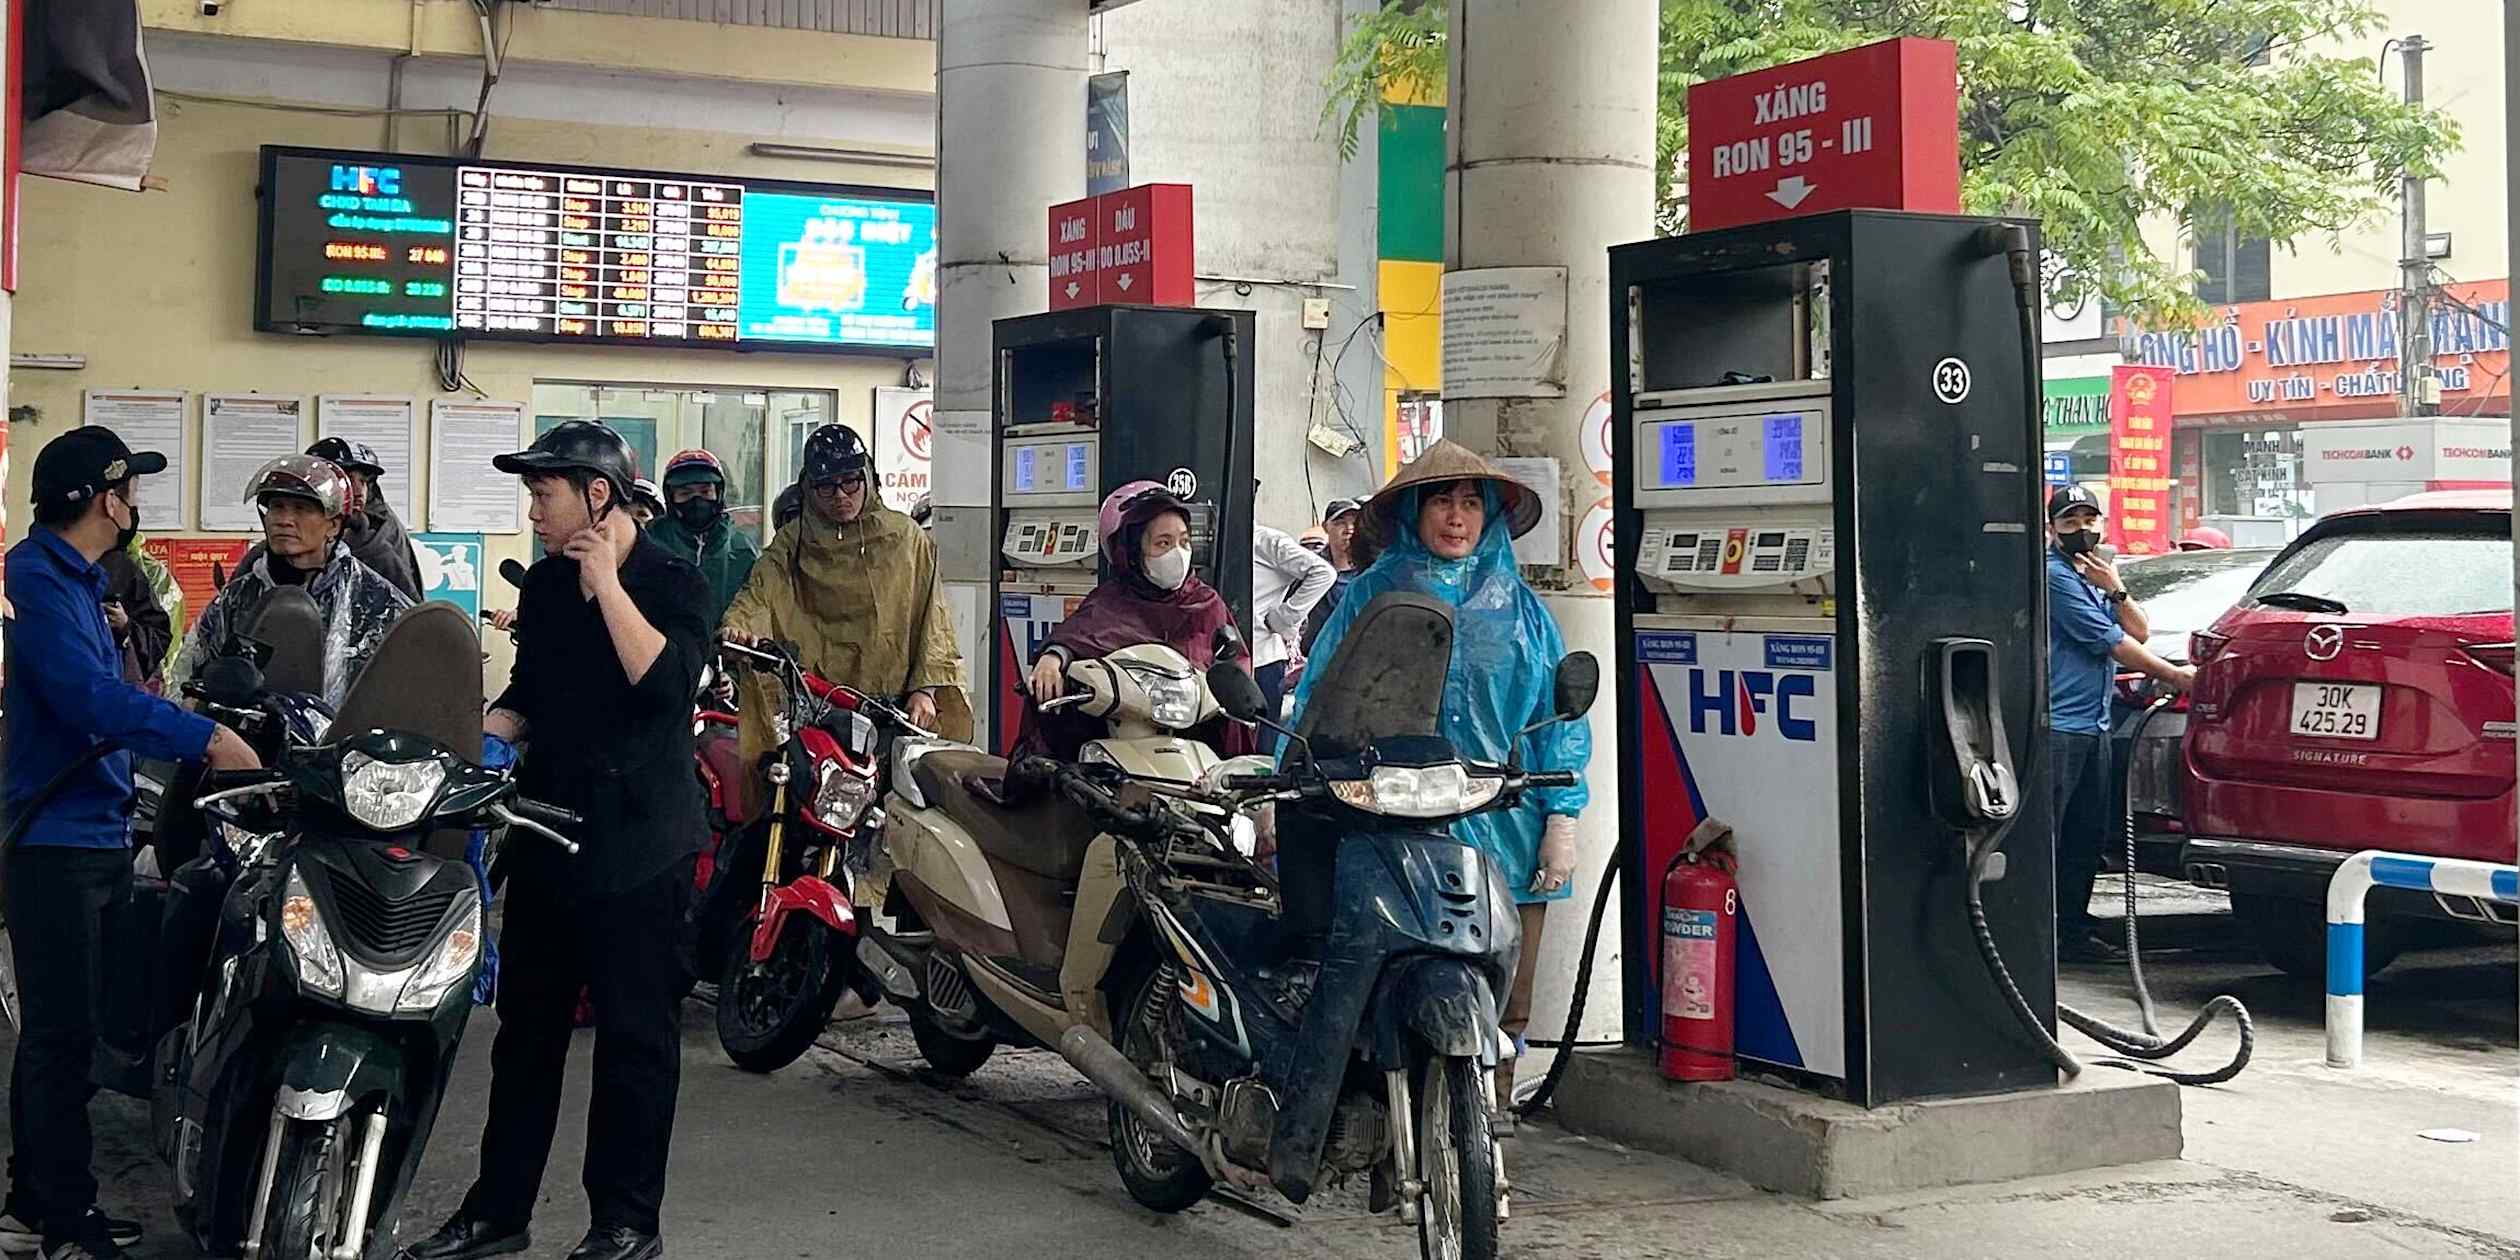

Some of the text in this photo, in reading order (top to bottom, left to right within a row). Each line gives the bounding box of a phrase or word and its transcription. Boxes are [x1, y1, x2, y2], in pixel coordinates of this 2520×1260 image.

[1754, 81, 1827, 125] XĂNG
[1713, 136, 1770, 178] RON
[1778, 129, 1813, 166] 95
[1842, 116, 1872, 154] III
[331, 165, 400, 195] HFC
[2199, 305, 2243, 373] HỒ
[2265, 308, 2344, 367] KÍNH
[1940, 366, 1964, 394] 33
[2248, 379, 2274, 403] UY
[2279, 372, 2314, 400] TÍN
[2336, 362, 2392, 396] CHẤT
[2322, 448, 2392, 461] TECHCOMBANK
[1689, 668, 1816, 742] HFC
[2317, 687, 2354, 710] 30K
[2300, 710, 2367, 735] 425.29
[2293, 751, 2367, 766] SIGNATURE
[1724, 888, 1736, 915] 8
